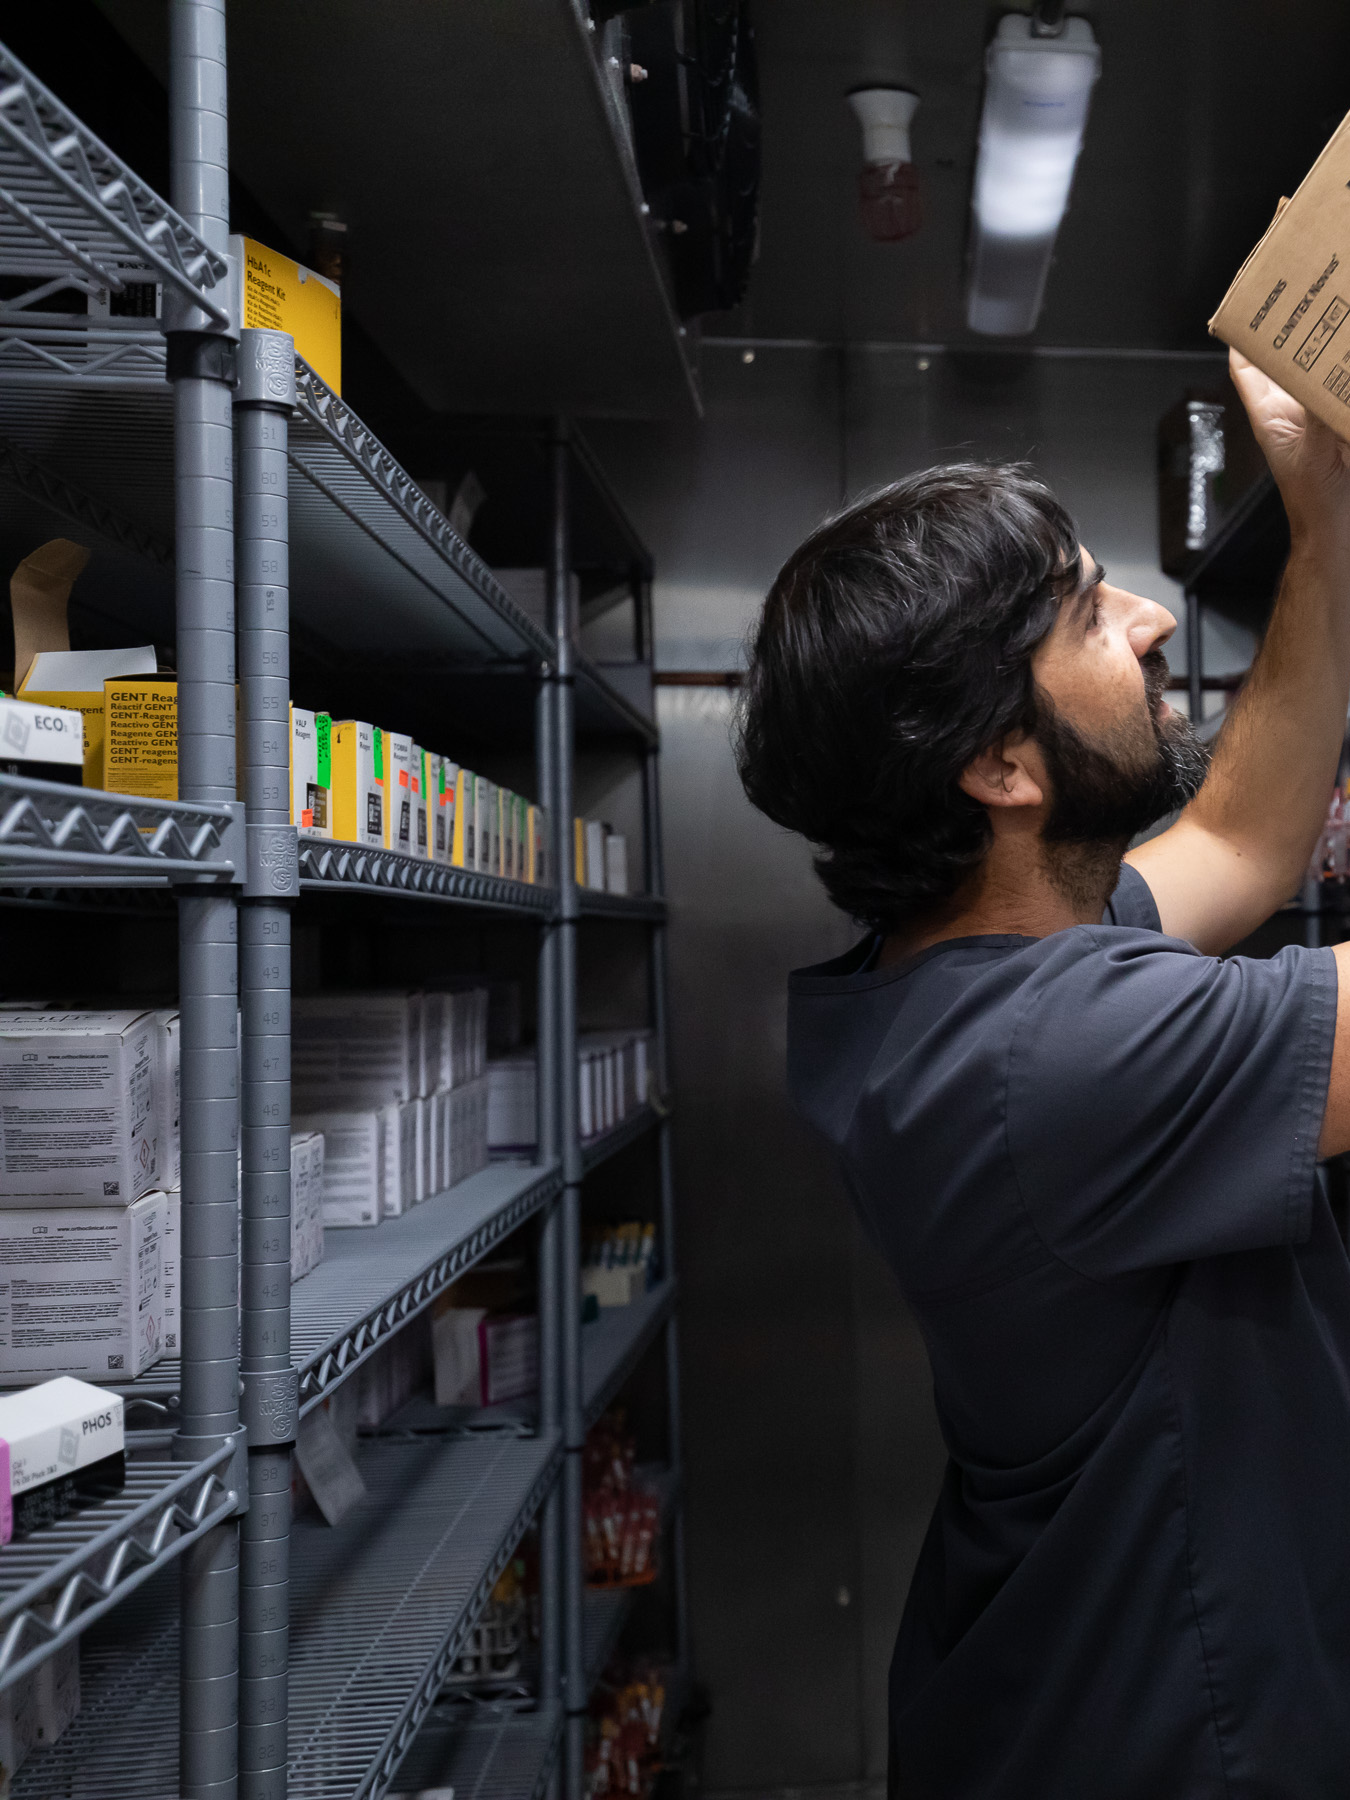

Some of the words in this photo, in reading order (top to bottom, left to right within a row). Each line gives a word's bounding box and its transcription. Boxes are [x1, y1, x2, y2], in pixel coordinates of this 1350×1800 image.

[1249, 279, 1287, 333] SIEMENS
[262, 652, 279, 664] 56
[111, 692, 148, 701] GENT
[262, 696, 279, 709] 55
[111, 703, 142, 711] Réactif
[144, 703, 173, 711] GENT
[111, 721, 149, 729] Reactivo
[111, 730, 152, 739] Reagente
[262, 740, 279, 753] 54
[110, 756, 178, 766] GENT-reagens
[262, 787, 279, 800] 53
[262, 921, 280, 935] 50
[262, 966, 280, 979] 49
[262, 1011, 280, 1025] 48
[262, 1058, 280, 1071] 47
[262, 1103, 280, 1116] 46
[82, 1411, 112, 1435] PHOS
